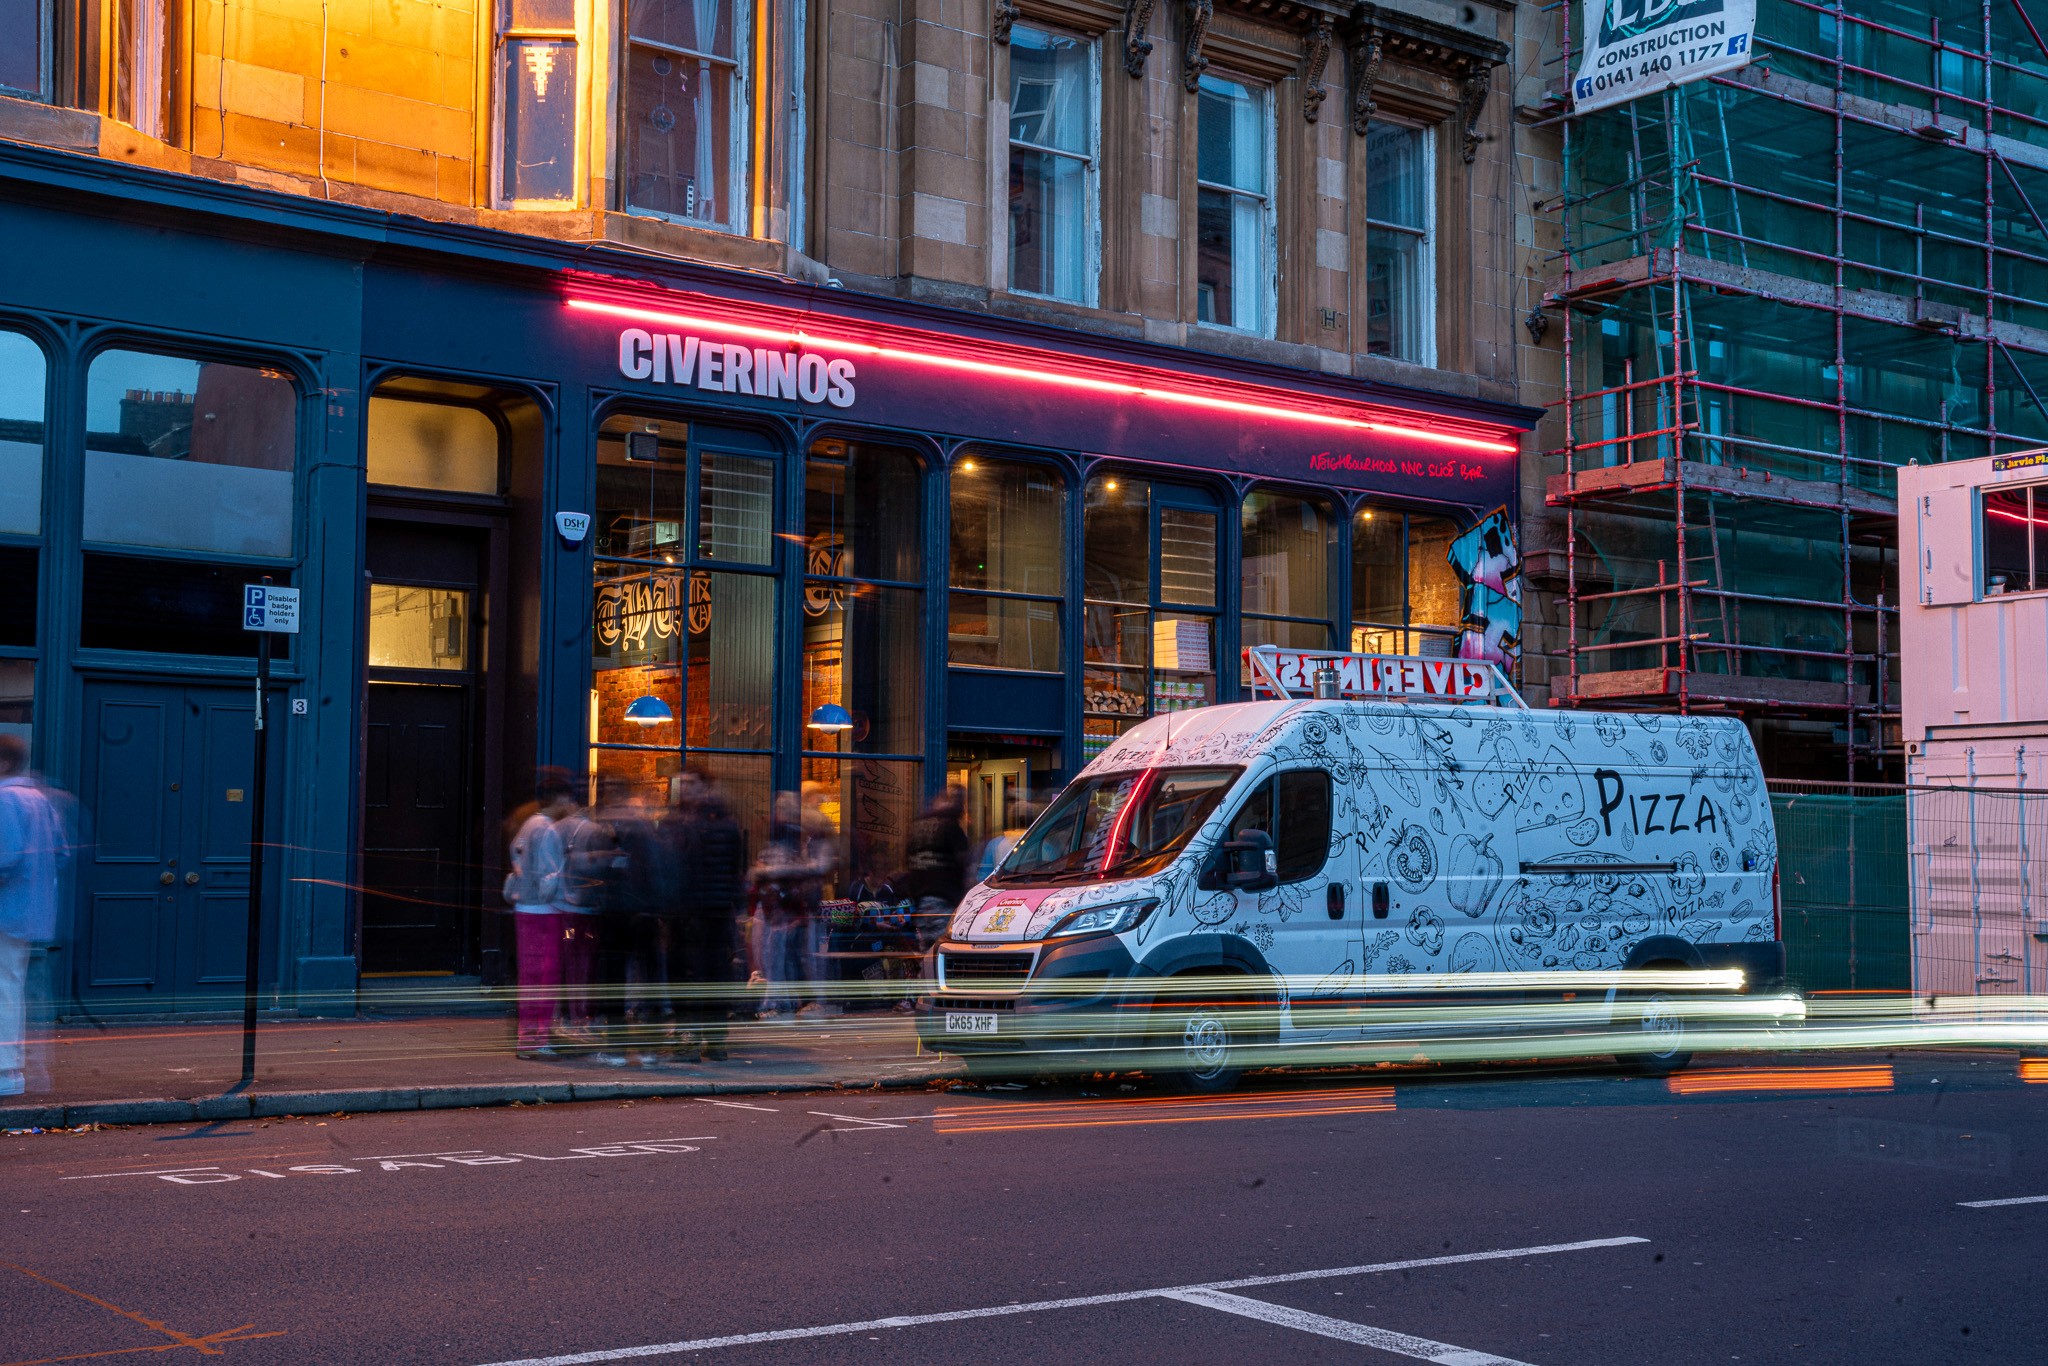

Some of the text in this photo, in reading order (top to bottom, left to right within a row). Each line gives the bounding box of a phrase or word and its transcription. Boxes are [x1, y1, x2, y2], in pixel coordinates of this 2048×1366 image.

[1598, 21, 1725, 68] CONSTRUCTION
[1595, 67, 1633, 91] 0141
[1640, 54, 1672, 77] 440
[1679, 42, 1724, 66] 1177
[619, 328, 856, 408] CIVERINOS
[1309, 451, 1398, 474] NEIGHBOURHOOD
[1401, 460, 1425, 477] NYC
[1428, 460, 1457, 478] SLICE
[564, 518, 586, 528] DSM
[251, 589, 263, 604] P
[267, 595, 297, 603] Disabled
[271, 602, 293, 610] badge
[269, 609, 295, 617] holders
[274, 617, 290, 625] only
[295, 700, 305, 713] 3
[1503, 758, 1537, 805] PIZZA
[1594, 767, 1717, 837] PIZZA
[1356, 805, 1393, 853] PIZZA
[1668, 897, 1705, 928] PIZZA
[949, 1015, 994, 1031] GK65 XHF
[158, 1144, 701, 1185] DISABLED
